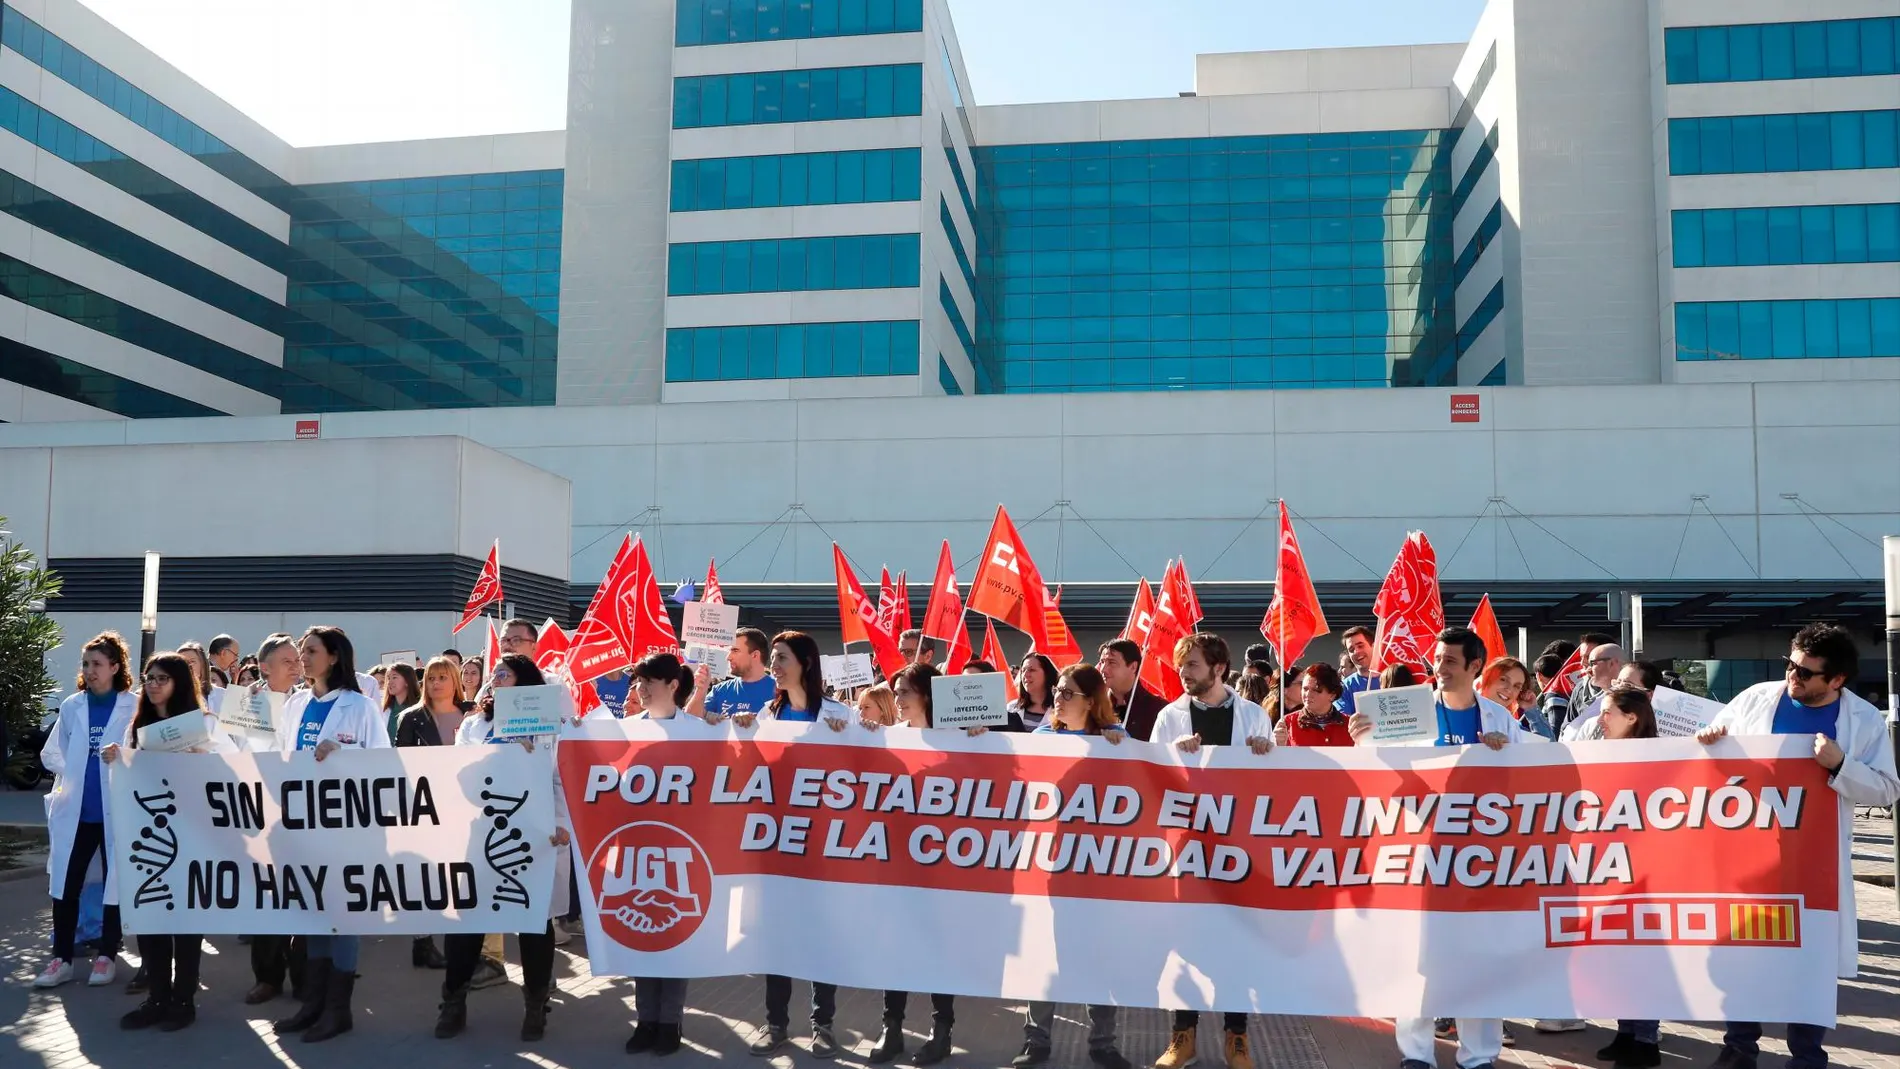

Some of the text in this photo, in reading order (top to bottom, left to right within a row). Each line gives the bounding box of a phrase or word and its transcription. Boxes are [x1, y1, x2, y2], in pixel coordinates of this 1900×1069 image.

[737, 702, 751, 710] SIN
[954, 705, 989, 713] INVESTIGO
[305, 722, 321, 730] SIN
[507, 717, 540, 725] INVESTIGO
[1386, 717, 1418, 726] INVESTIGO
[1664, 712, 1697, 726] INVESTIGO
[1443, 734, 1465, 744] SIN
[205, 776, 441, 830] SIN CIENCIA
[583, 764, 1808, 837] POR LA ESTABILIDAD EN LA INVESTIGACIÓN
[739, 814, 1635, 887] DE LA COMUNIDAD VALENCIANA
[601, 845, 696, 893] UGT
[187, 860, 478, 913] NO HAY SALUD
[1549, 902, 1717, 944] CCOO
